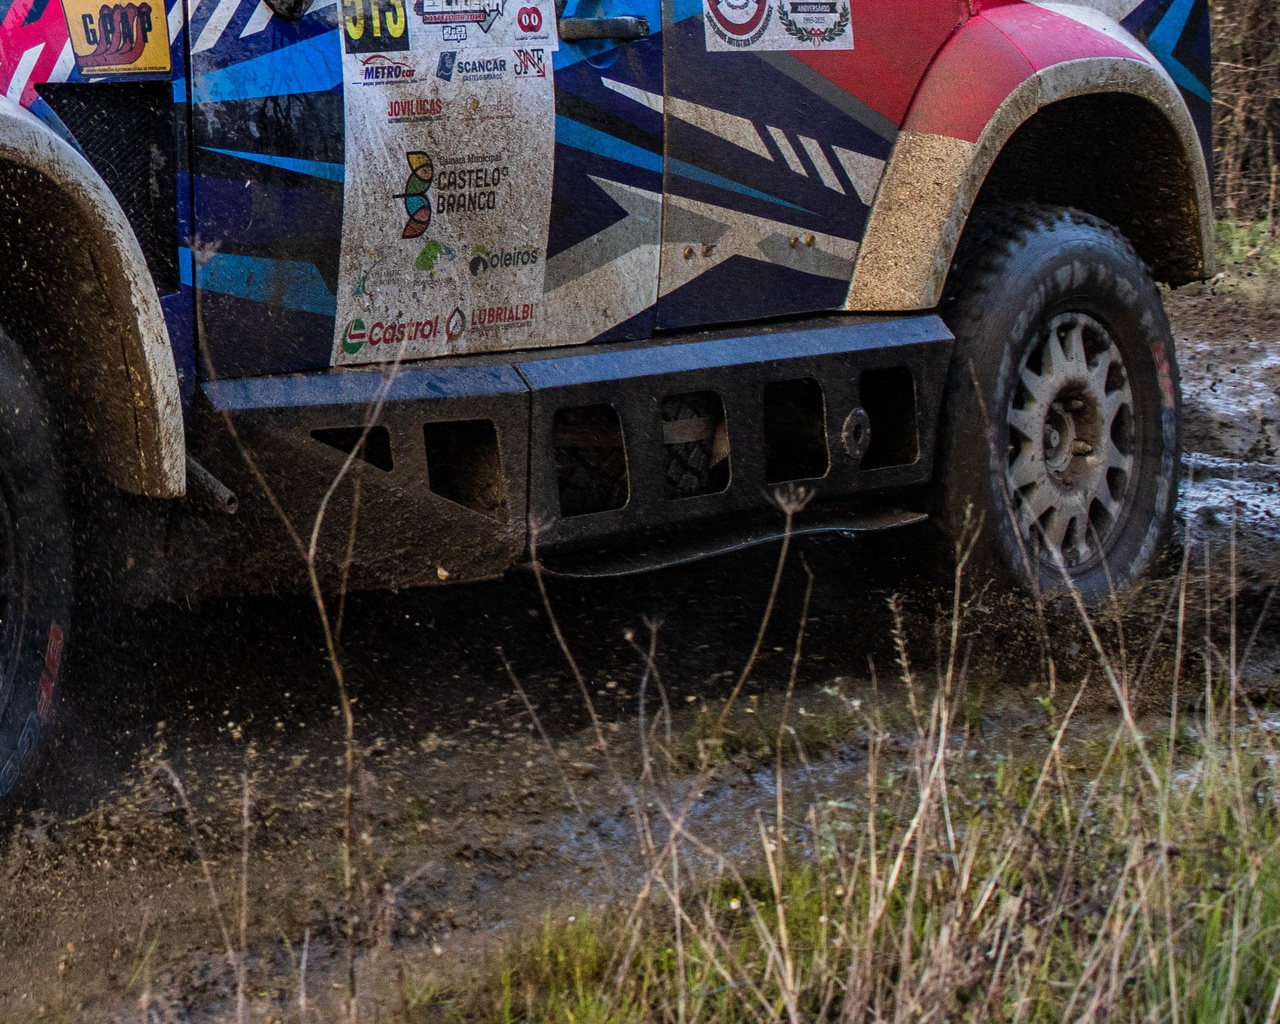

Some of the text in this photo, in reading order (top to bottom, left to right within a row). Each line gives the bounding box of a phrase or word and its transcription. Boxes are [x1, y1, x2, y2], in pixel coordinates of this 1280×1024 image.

[457, 59, 507, 74] SCANCAR
[388, 98, 443, 117] JOVILUCAS
[437, 167, 501, 191] CASTELO
[437, 191, 496, 214] BRANCO
[490, 248, 538, 268] oleiros
[471, 303, 534, 326] LUBRIALBI
[369, 316, 439, 346] Castrol
